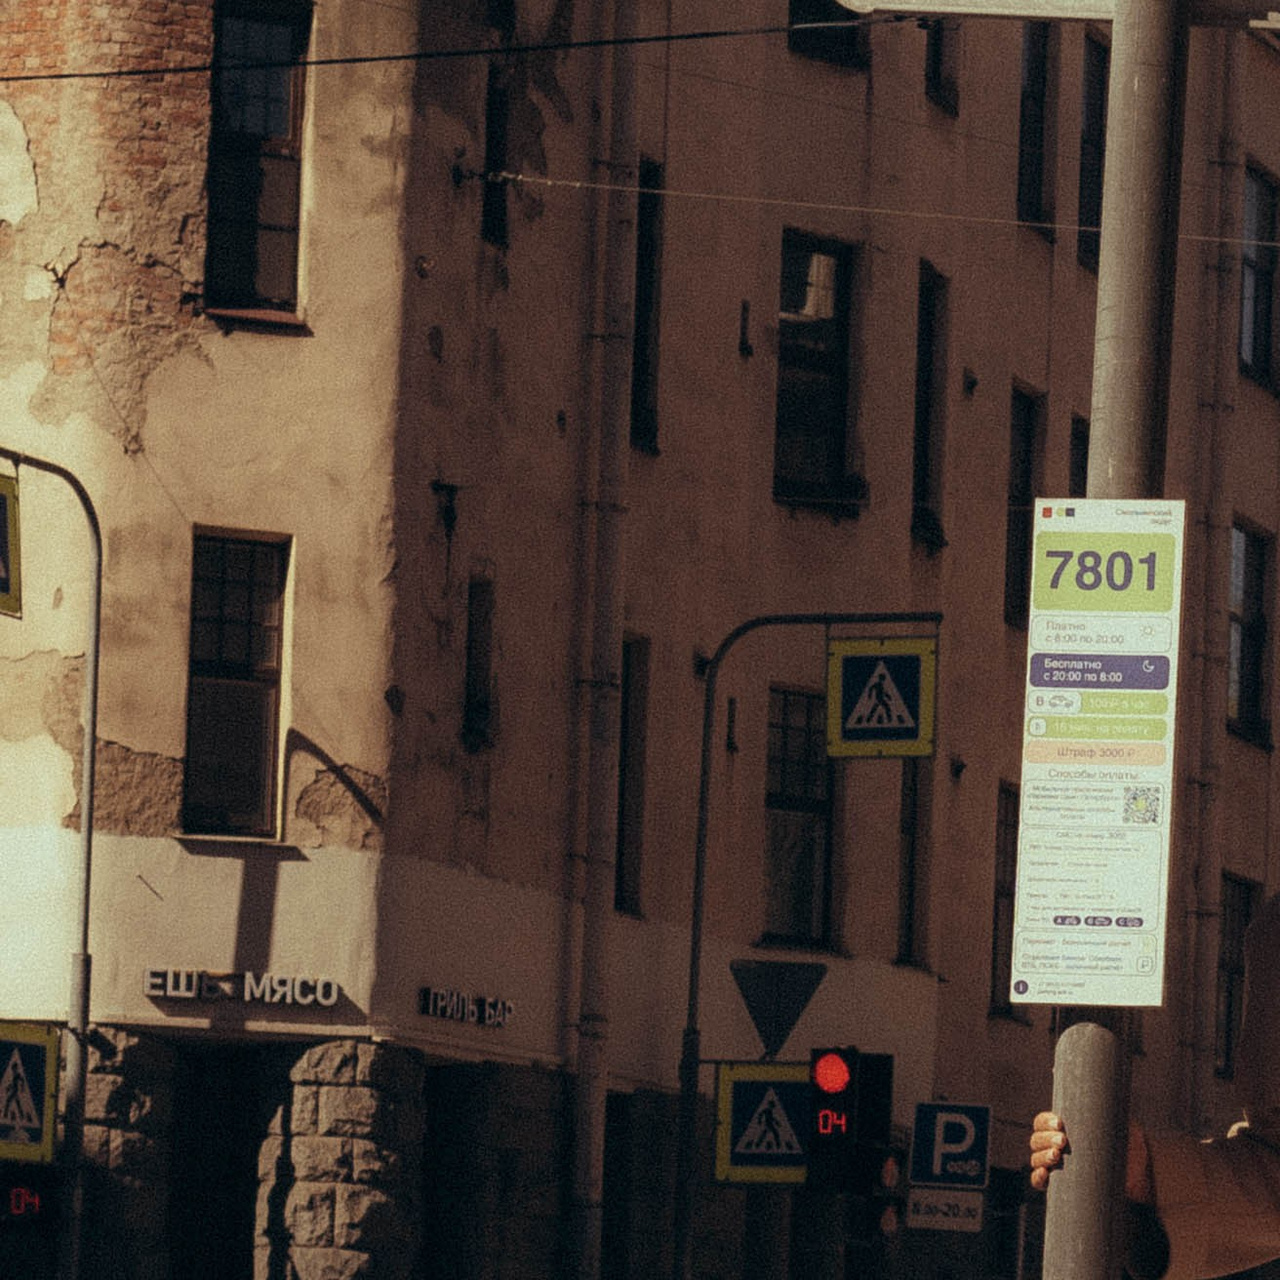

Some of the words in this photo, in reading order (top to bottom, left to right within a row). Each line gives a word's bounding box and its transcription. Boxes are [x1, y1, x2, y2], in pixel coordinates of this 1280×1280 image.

[1045, 550, 1157, 591] 7801
[1046, 621, 1085, 630] Платно
[1044, 658, 1102, 669] Бесплатно
[1053, 671, 1081, 681] 20:00
[1085, 673, 1097, 681] по
[1099, 672, 1123, 682] 8:00
[1057, 747, 1097, 759] Штраф
[1099, 748, 1124, 757] 3000
[1048, 769, 1097, 779] Способы
[244, 970, 338, 1006] МЯСО
[429, 987, 478, 1022] ГРИЛЬ
[485, 998, 514, 1026] БАР
[818, 1109, 846, 1134] 04
[932, 1112, 976, 1175] P
[10, 1187, 39, 1214] 04
